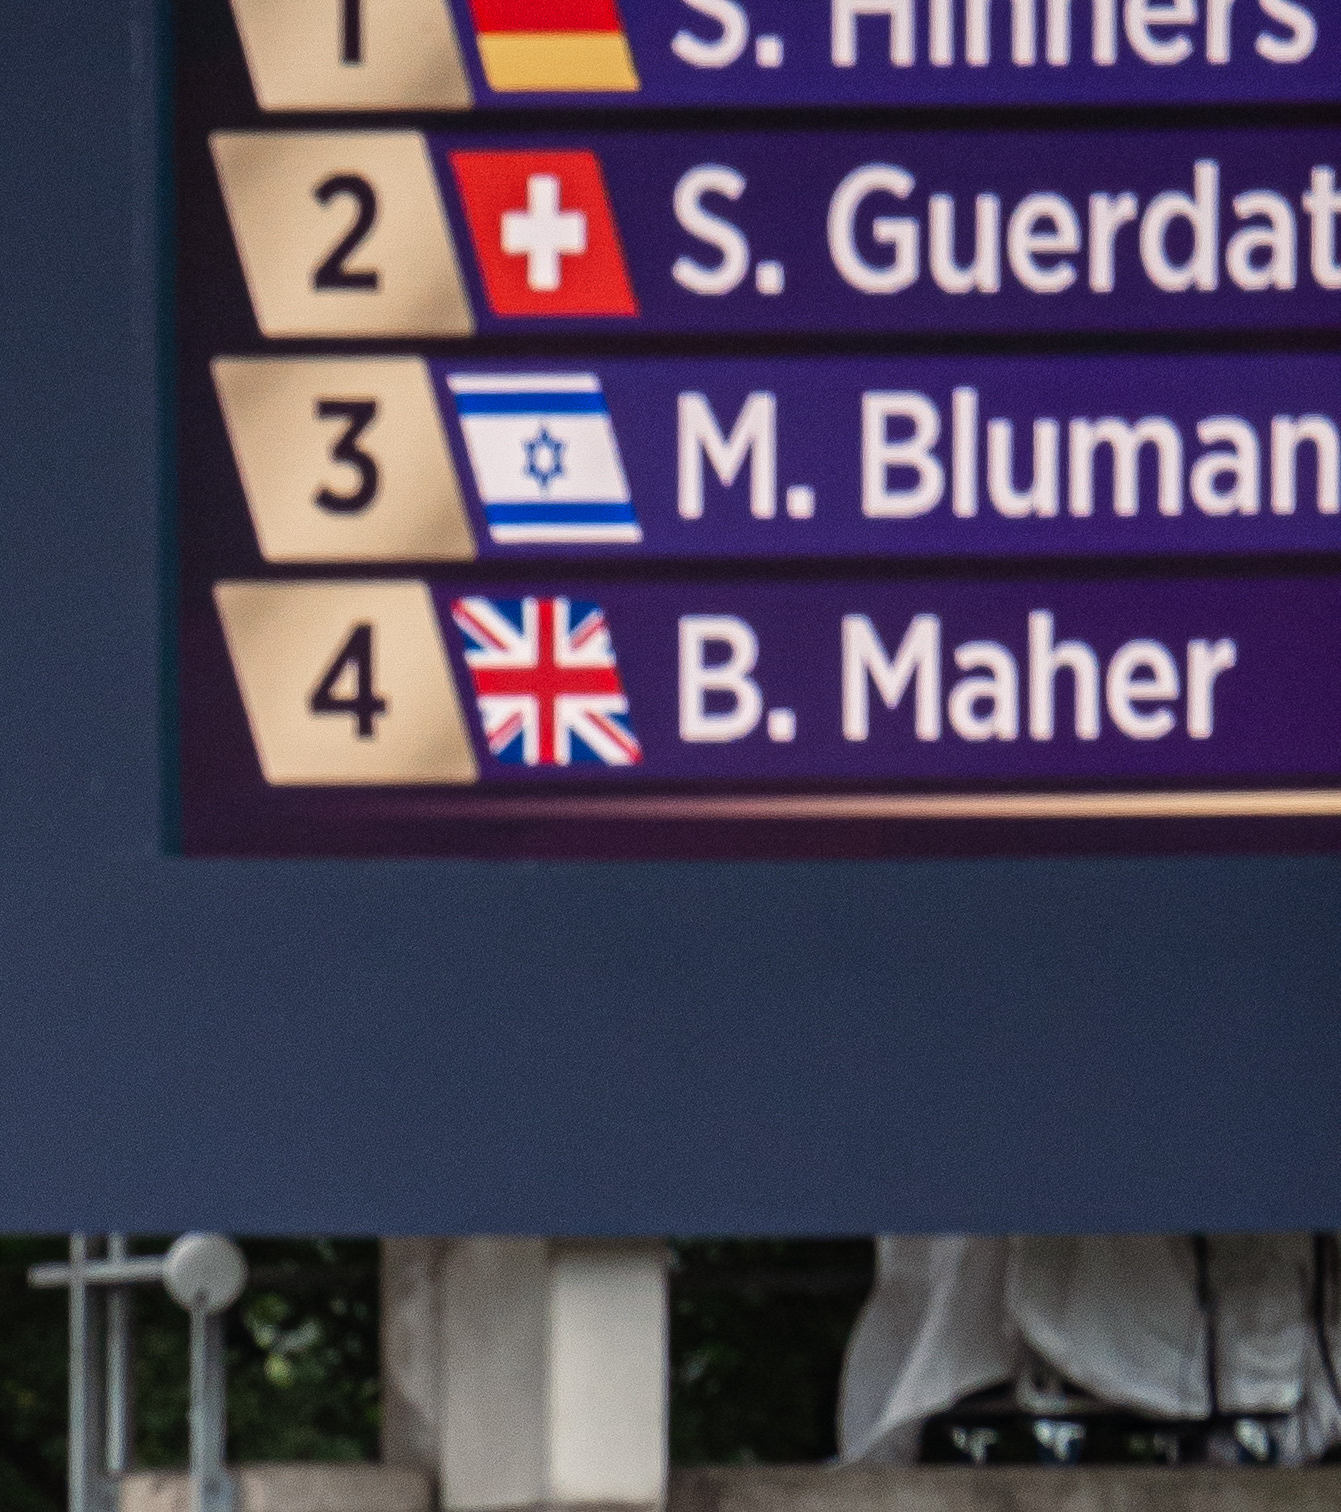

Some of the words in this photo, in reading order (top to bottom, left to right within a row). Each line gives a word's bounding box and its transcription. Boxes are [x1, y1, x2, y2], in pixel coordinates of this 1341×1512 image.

[338, 0, 364, 67] 1
[671, 0, 784, 68] S.
[829, 0, 1318, 68] Hinners
[311, 172, 381, 293] 2
[671, 166, 785, 295] S.
[826, 159, 1341, 294] Guerdat
[314, 398, 381, 517] 3
[676, 391, 815, 520] M.
[860, 385, 1341, 519] Bluman
[308, 622, 388, 740] 4
[677, 615, 797, 743] B.
[841, 610, 1238, 742] Maher
